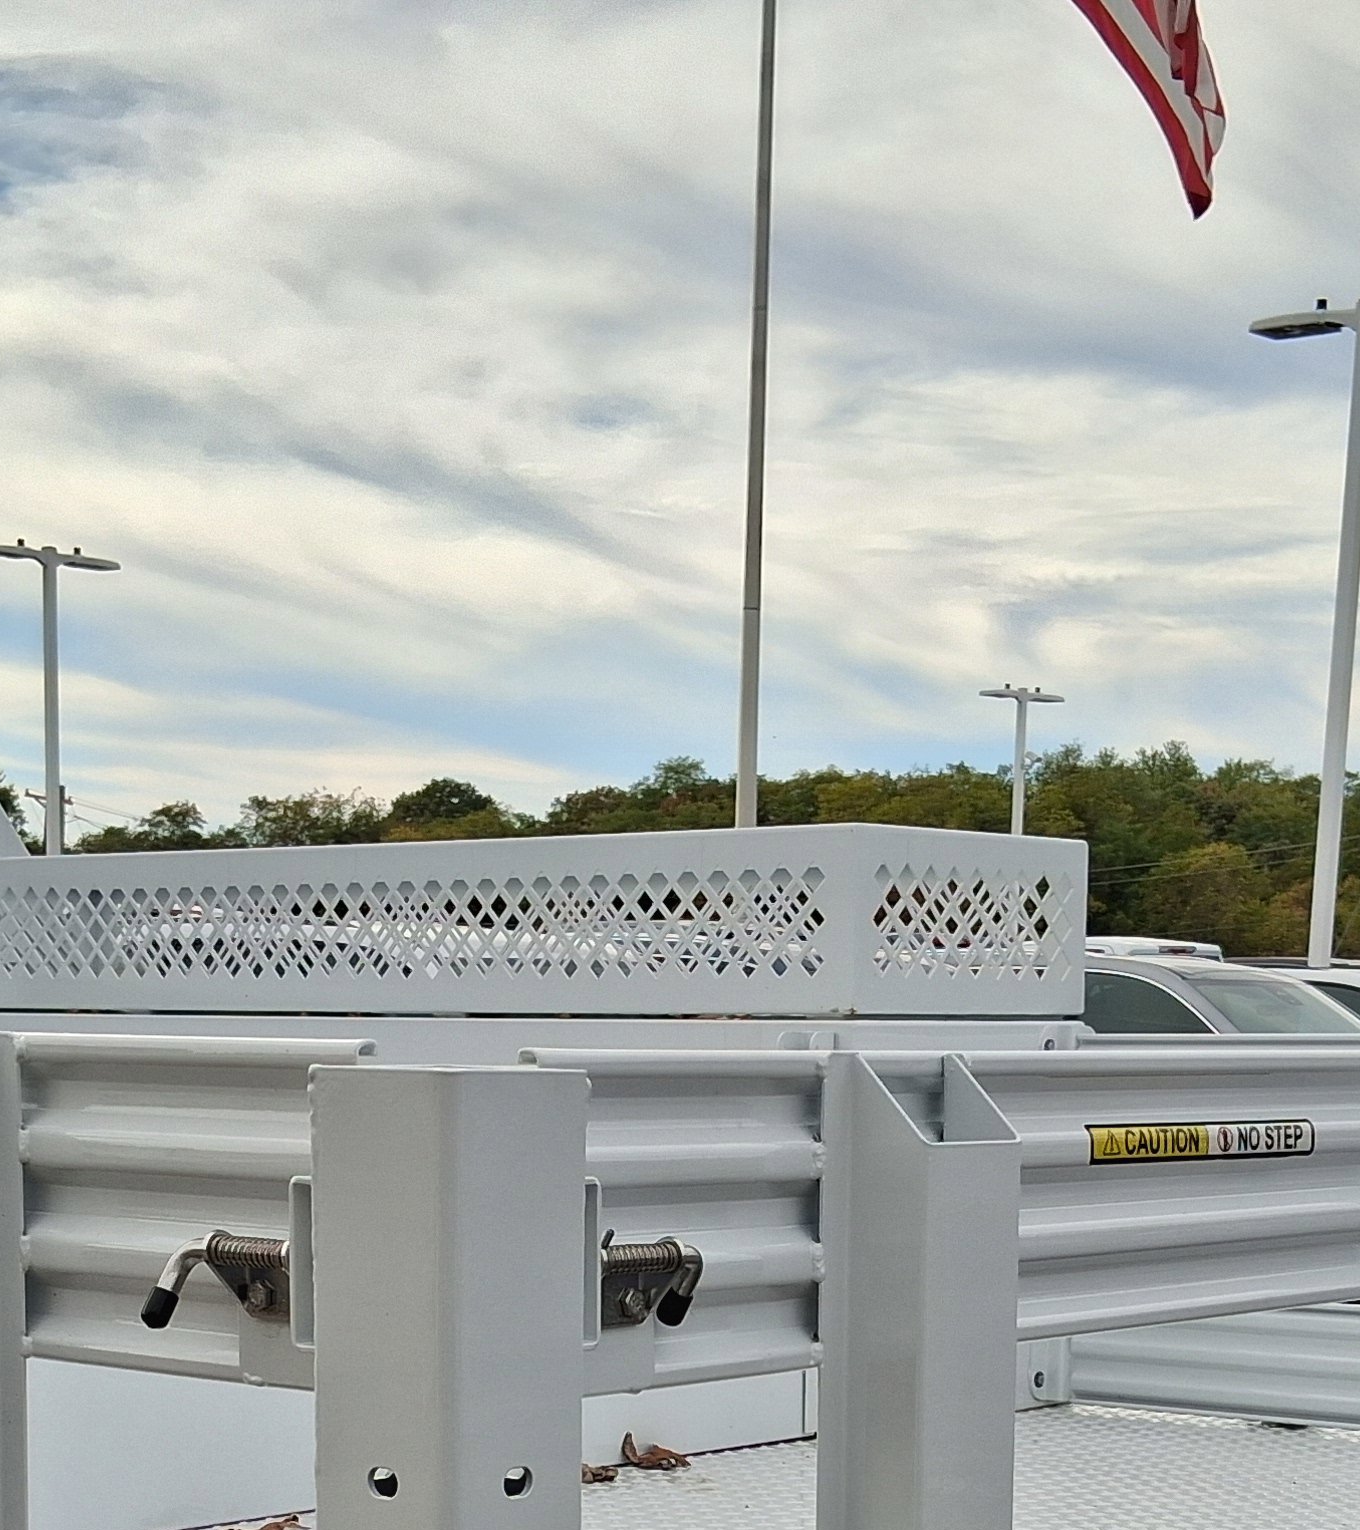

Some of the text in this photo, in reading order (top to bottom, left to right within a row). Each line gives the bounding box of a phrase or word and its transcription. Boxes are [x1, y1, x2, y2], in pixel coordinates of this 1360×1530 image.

[1124, 1127, 1201, 1155] CAUTION
[1237, 1124, 1304, 1152] NO STEP
